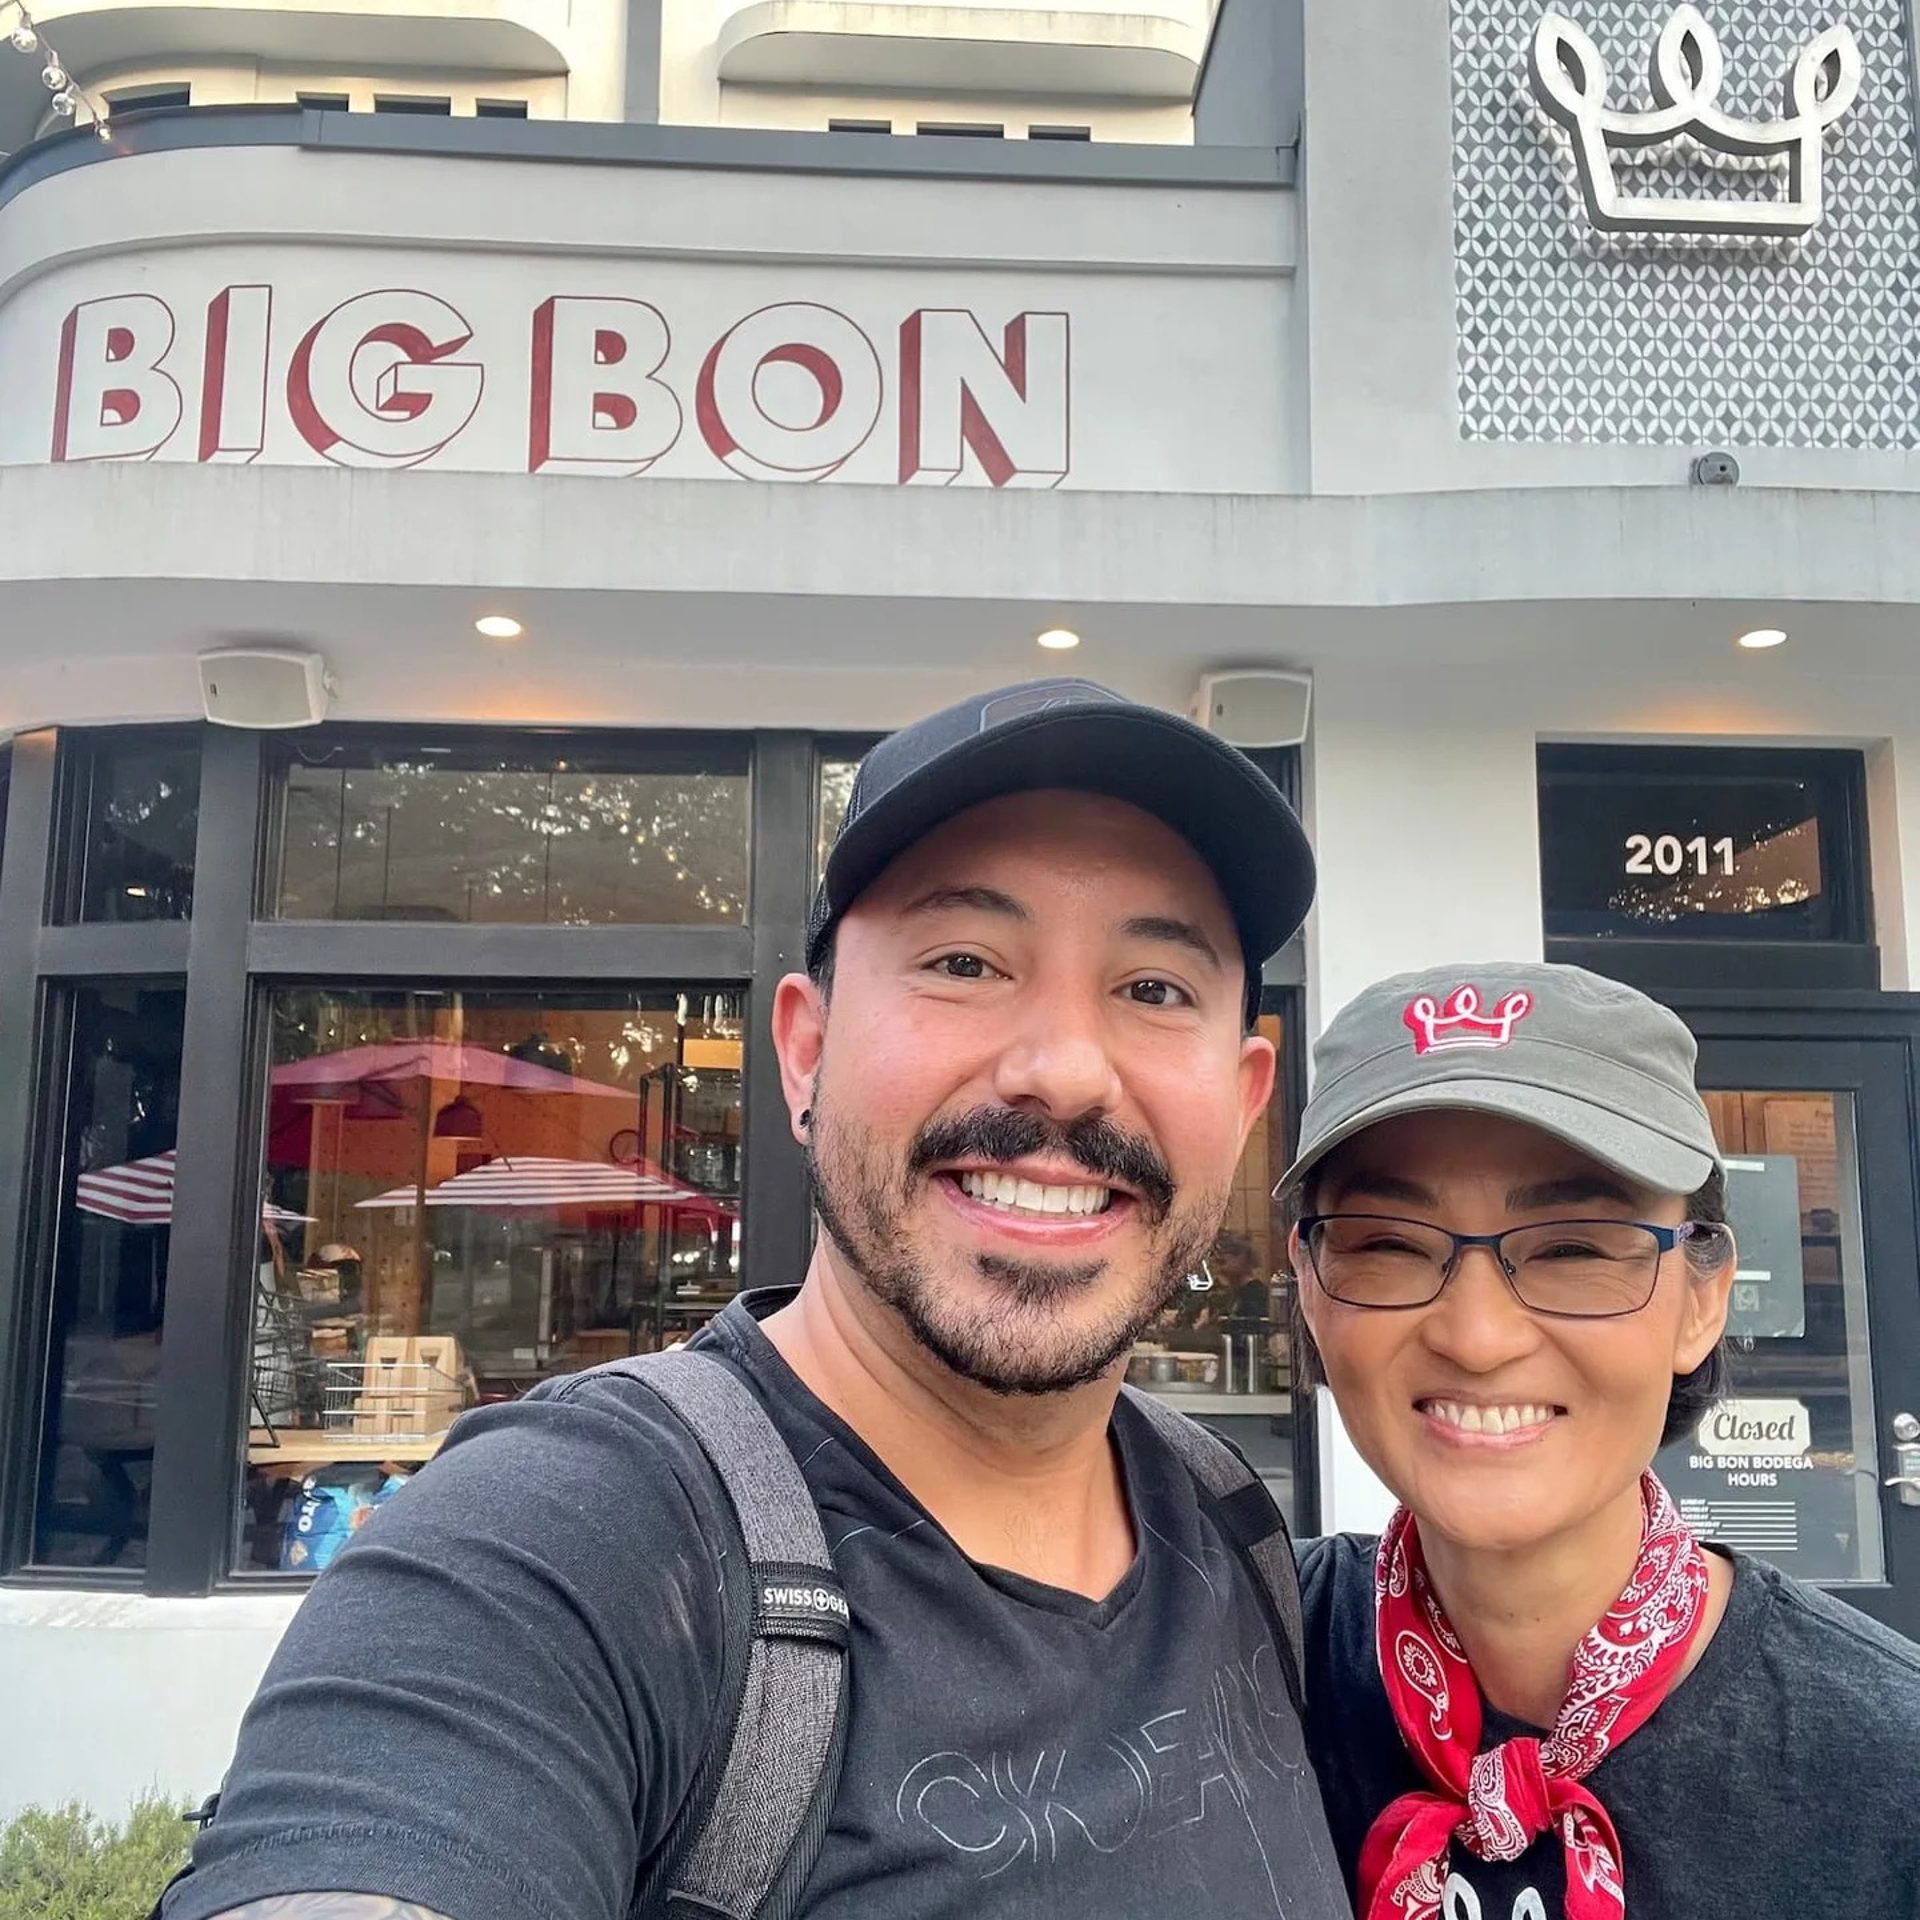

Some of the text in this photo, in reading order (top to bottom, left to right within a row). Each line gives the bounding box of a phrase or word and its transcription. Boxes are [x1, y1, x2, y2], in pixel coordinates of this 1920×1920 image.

[51, 285, 1070, 489] BIG BON
[1625, 834, 1735, 876] 2011
[1713, 1413, 1796, 1441] Closed
[1689, 1456, 1813, 1469] BIG BON BODEGA
[1728, 1473, 1778, 1486] HOURS
[763, 1588, 812, 1606] SWISS
